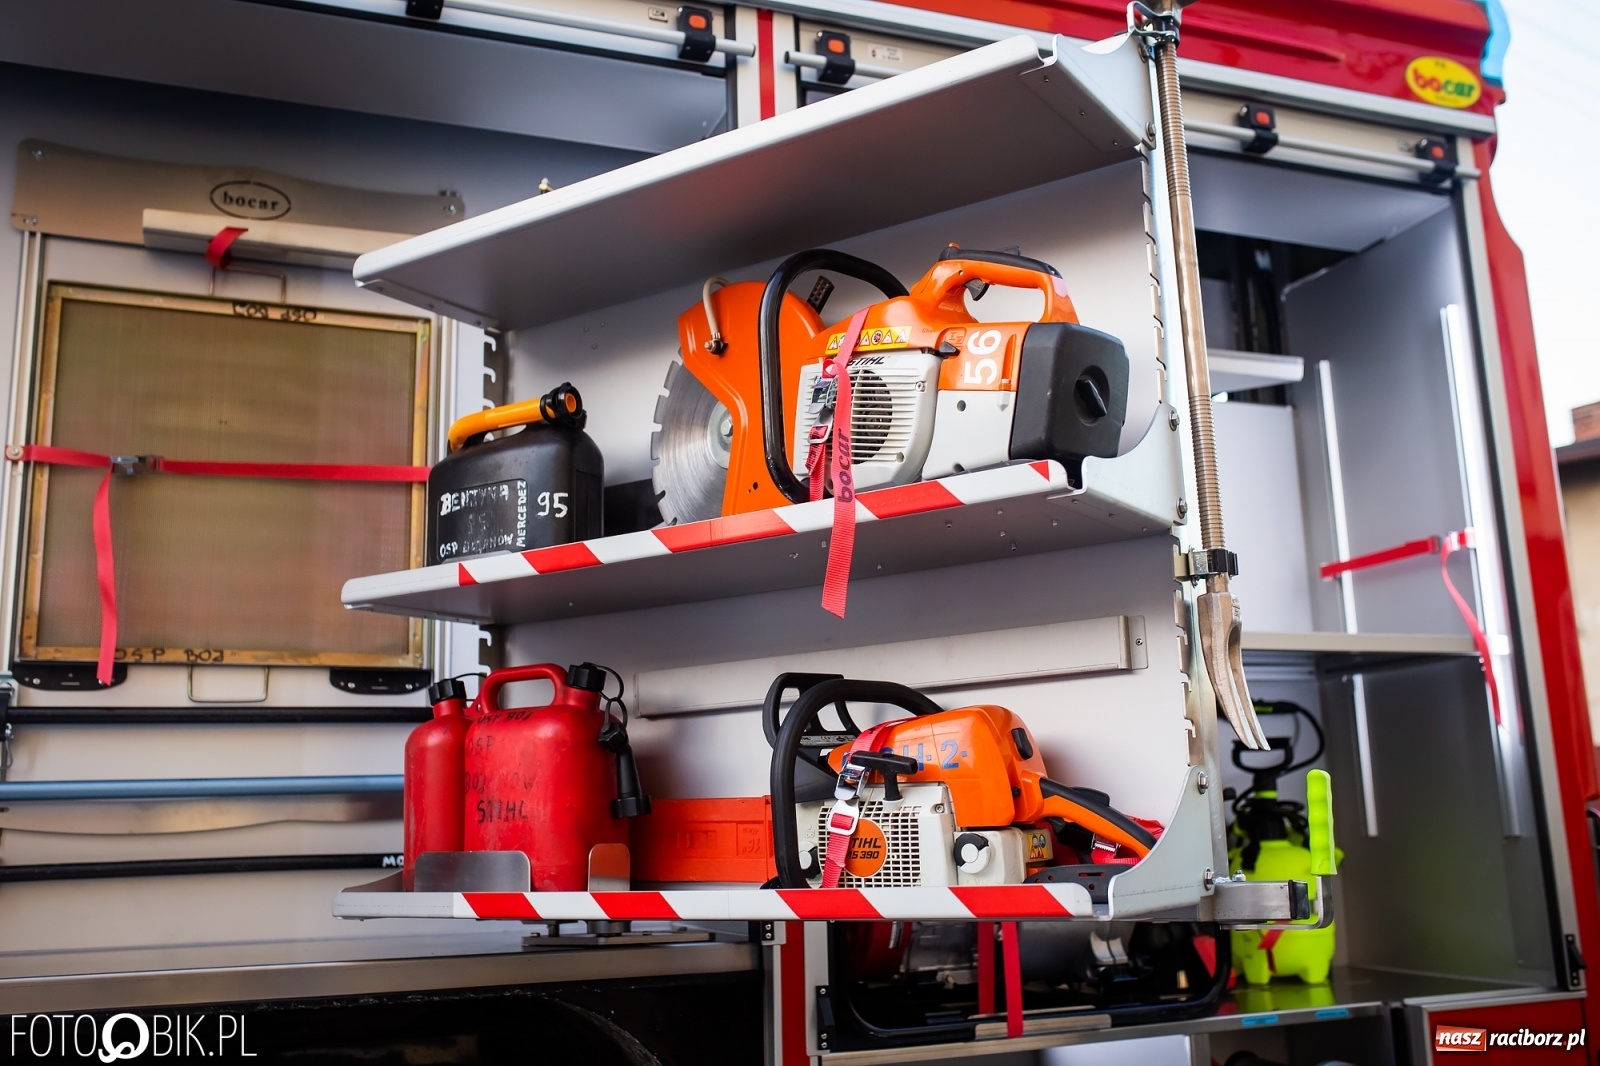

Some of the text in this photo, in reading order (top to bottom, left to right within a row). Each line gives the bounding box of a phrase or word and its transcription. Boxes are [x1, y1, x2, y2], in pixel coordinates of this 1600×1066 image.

[1412, 67, 1475, 97] bocar
[221, 190, 280, 211] bocar
[847, 355, 886, 367] STIHL
[963, 329, 1002, 385] 56
[837, 428, 853, 503] bocar
[516, 481, 527, 547] MERCEDEZ
[537, 491, 569, 518] 95
[440, 541, 459, 558] OSP
[851, 837, 882, 849] TIHL
[859, 850, 880, 860] 390
